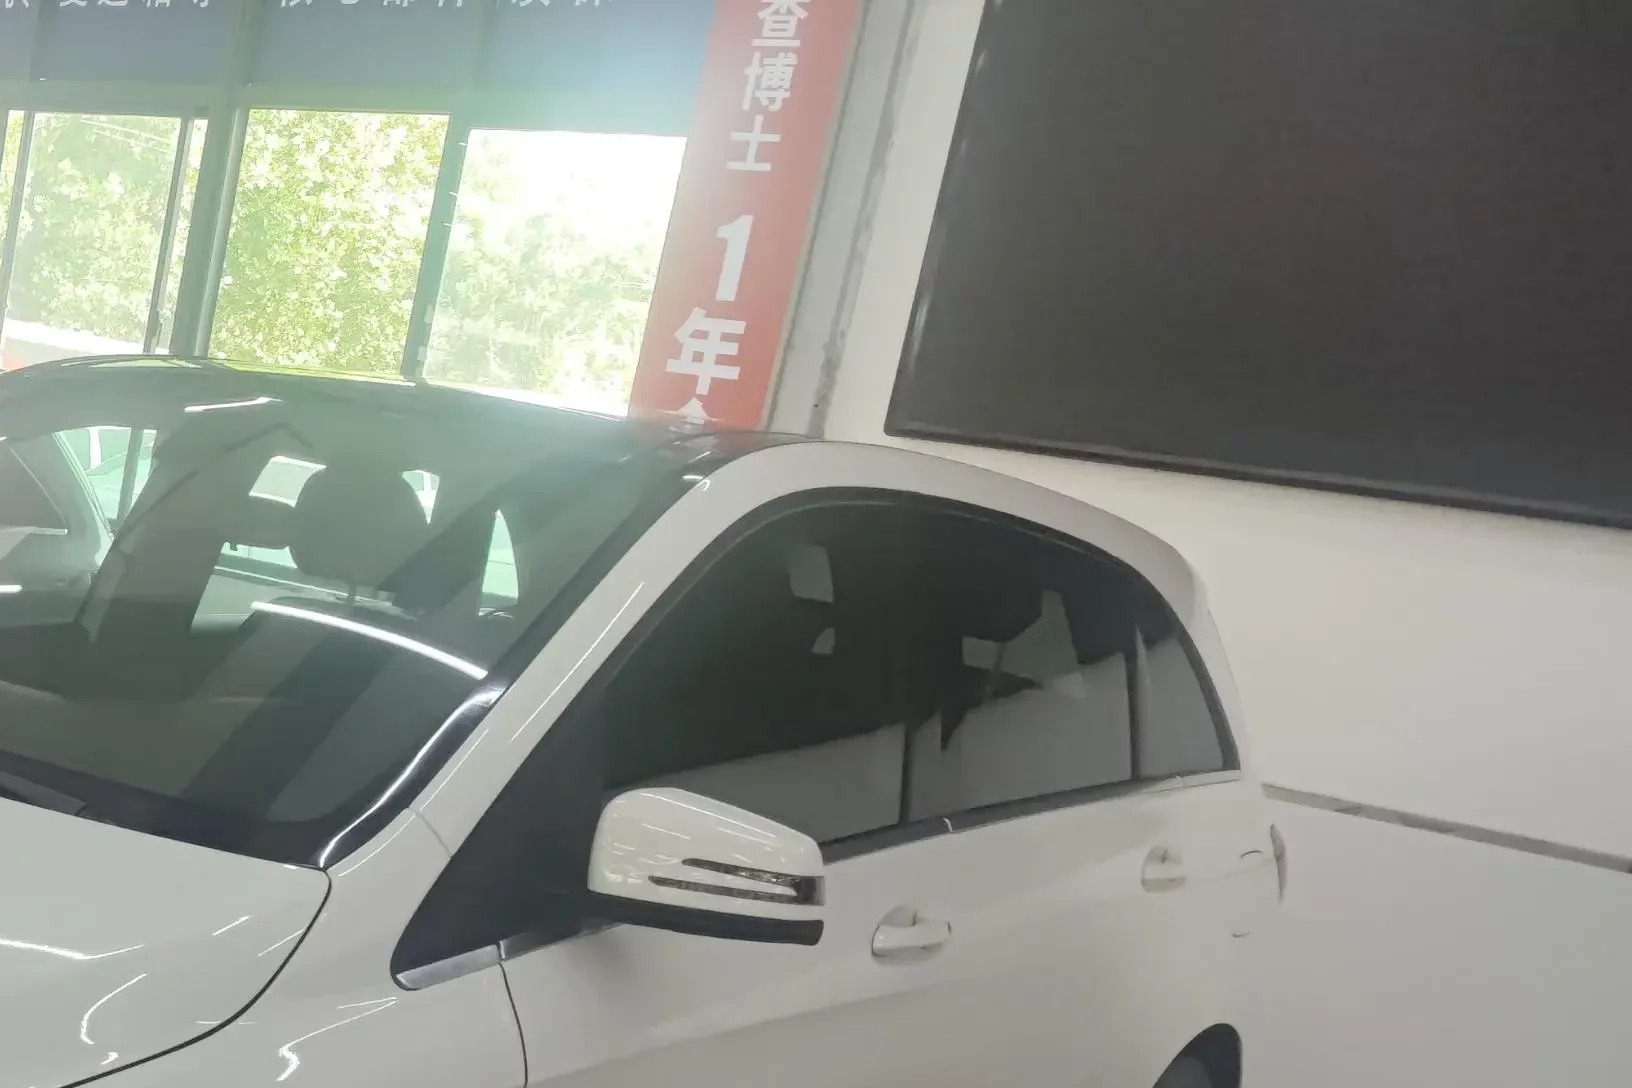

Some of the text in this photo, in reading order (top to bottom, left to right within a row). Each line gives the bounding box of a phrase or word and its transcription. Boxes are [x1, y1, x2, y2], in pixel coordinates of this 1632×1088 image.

[665, 0, 810, 424] 查博士 1年
